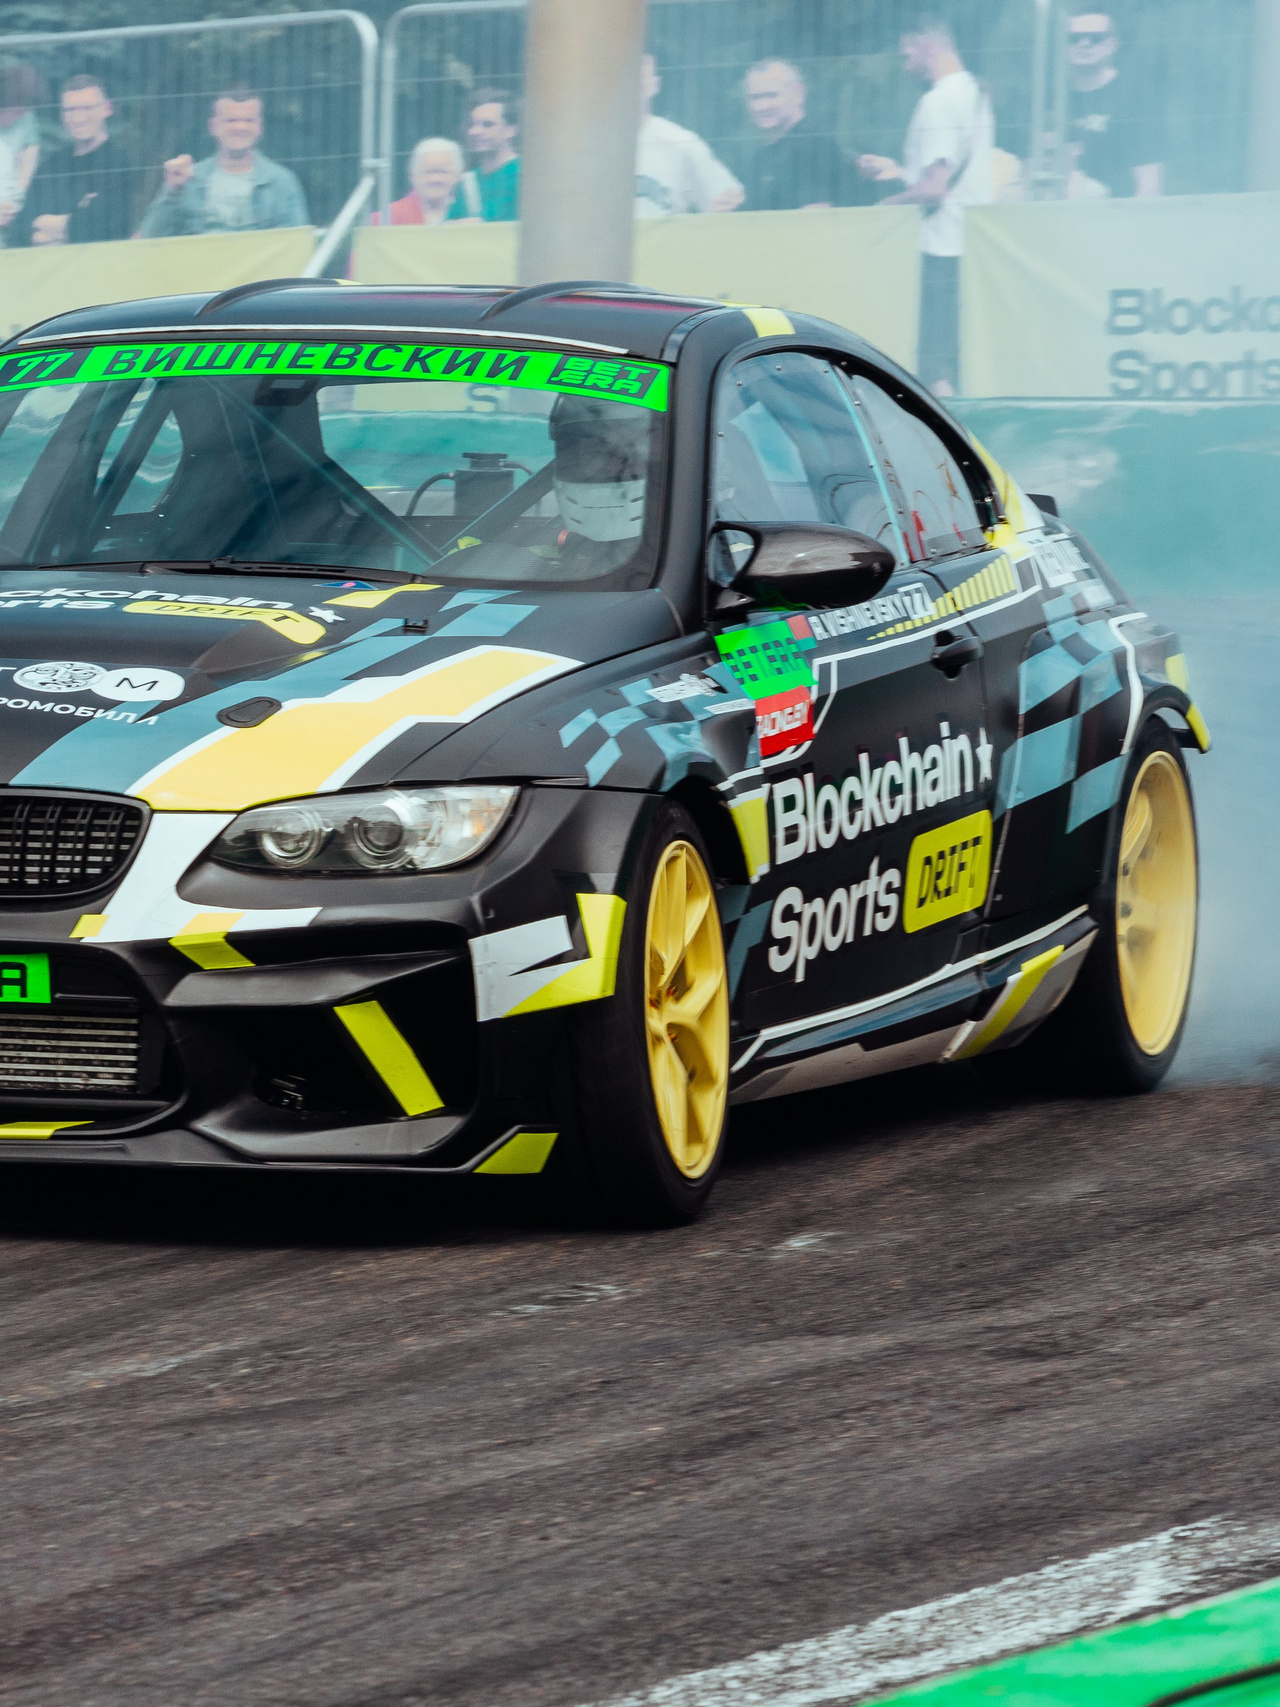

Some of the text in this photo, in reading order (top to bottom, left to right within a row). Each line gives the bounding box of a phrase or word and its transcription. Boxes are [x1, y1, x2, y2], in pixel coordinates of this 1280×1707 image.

[7, 351, 76, 383] 77
[563, 356, 651, 380] BET
[152, 604, 300, 624] DRIFT
[772, 721, 975, 866] Blockchain
[768, 834, 984, 984] Sports DRIFT
